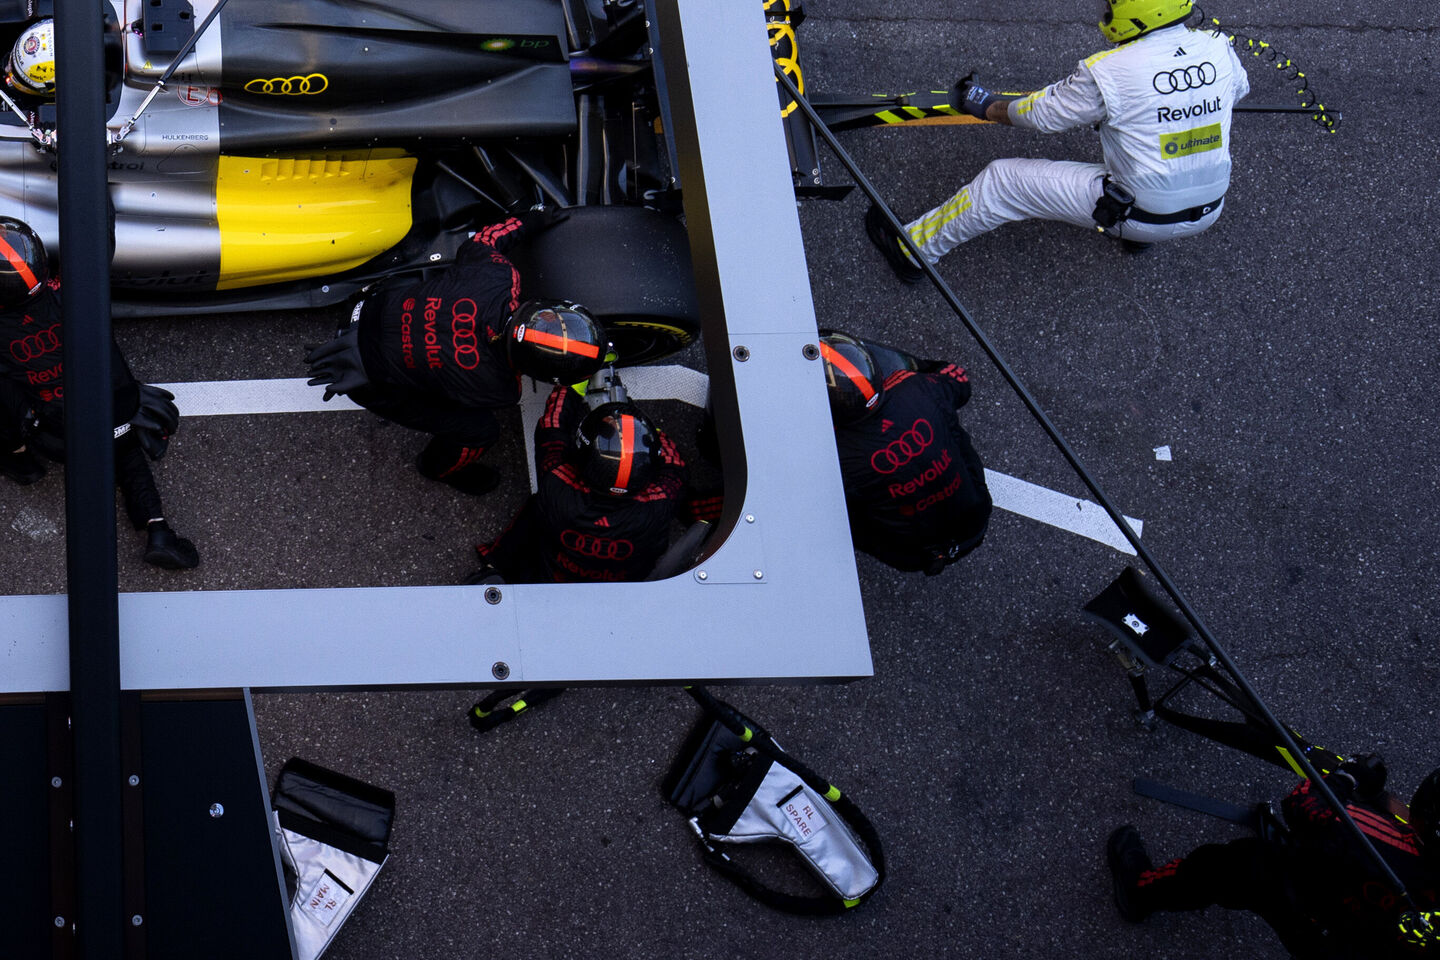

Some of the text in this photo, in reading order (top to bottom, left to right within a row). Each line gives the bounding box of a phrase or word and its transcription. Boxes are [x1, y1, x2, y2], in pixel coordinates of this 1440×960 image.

[1157, 96, 1222, 123] Revolut
[1180, 133, 1221, 151] ultimate
[401, 312, 417, 369] Castrol
[424, 297, 442, 370] Revolut
[888, 448, 953, 499] Revolut
[785, 803, 812, 837] SPARE
[802, 805, 816, 820] RL
[310, 883, 331, 910] MAIN
[324, 898, 337, 911] RL
